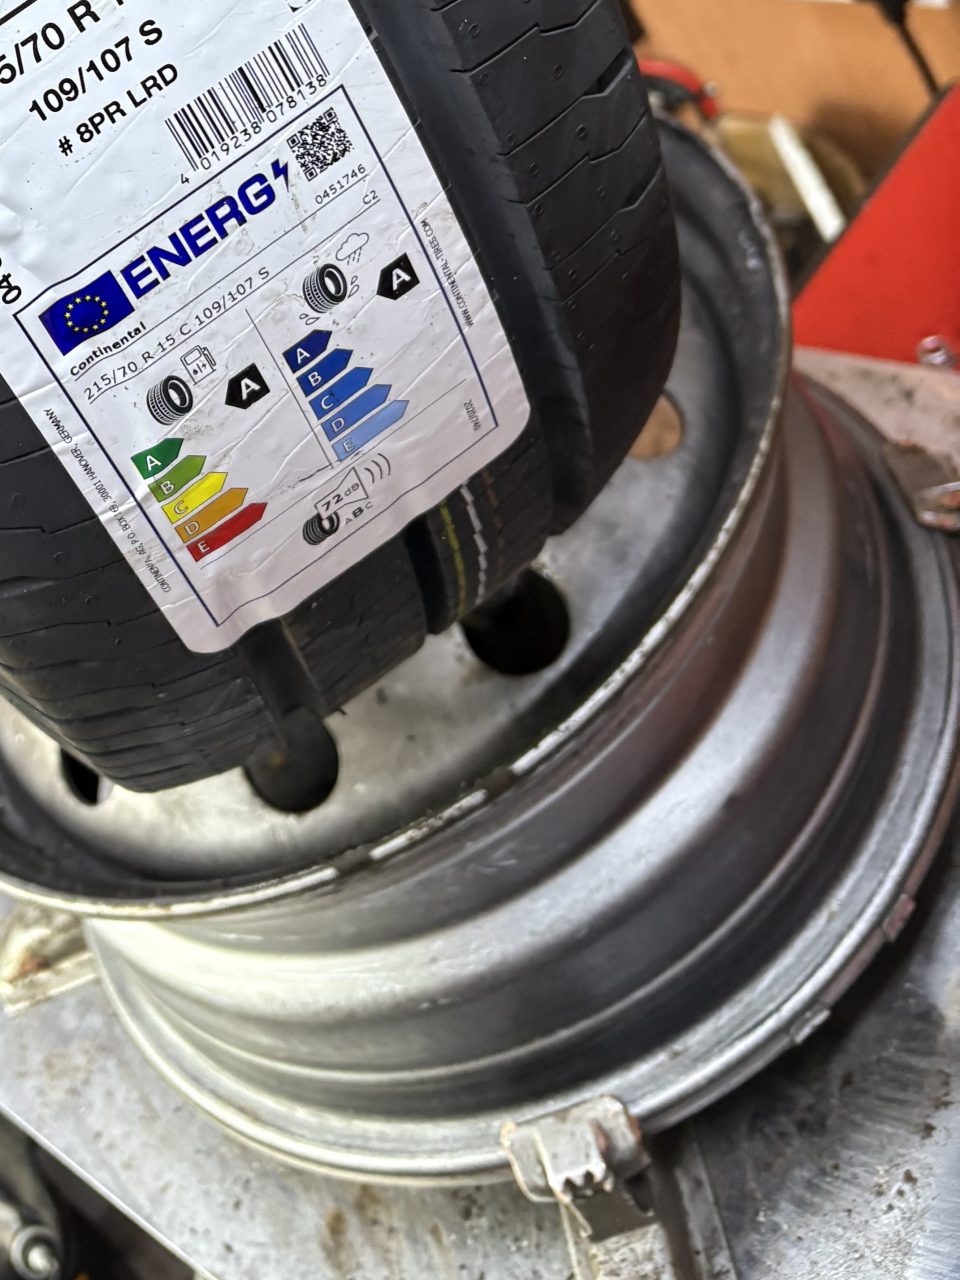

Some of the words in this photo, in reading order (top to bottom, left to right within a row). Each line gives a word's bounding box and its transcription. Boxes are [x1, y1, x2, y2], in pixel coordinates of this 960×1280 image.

[67, 0, 100, 33] R
[29, 36, 133, 121] 109/107
[139, 19, 163, 46] S
[58, 135, 73, 156] #
[76, 100, 127, 143] 8PR
[126, 63, 178, 108] LRD
[200, 121, 262, 170] 019238
[265, 74, 327, 123] 078138
[314, 163, 366, 205] 0451746
[362, 189, 378, 205] C2
[391, 267, 411, 290] A
[84, 361, 138, 400] 215/70
[141, 351, 155, 364] R
[157, 334, 176, 352] 15
[179, 323, 192, 336] C
[194, 276, 253, 326] 109/107
[258, 266, 270, 280] S
[70, 322, 147, 377] Continental
[296, 347, 310, 364] A
[240, 377, 261, 400] A
[308, 371, 322, 387] B
[321, 394, 334, 409] C
[43, 408, 73, 444] GERMANY
[331, 417, 345, 432] D
[146, 454, 161, 471] A
[94, 479, 112, 503] 30001
[160, 480, 175, 495] B
[321, 494, 344, 512] 72
[344, 482, 360, 497] dB
[173, 499, 189, 515] C
[184, 521, 200, 535] D
[197, 540, 210, 553] E
